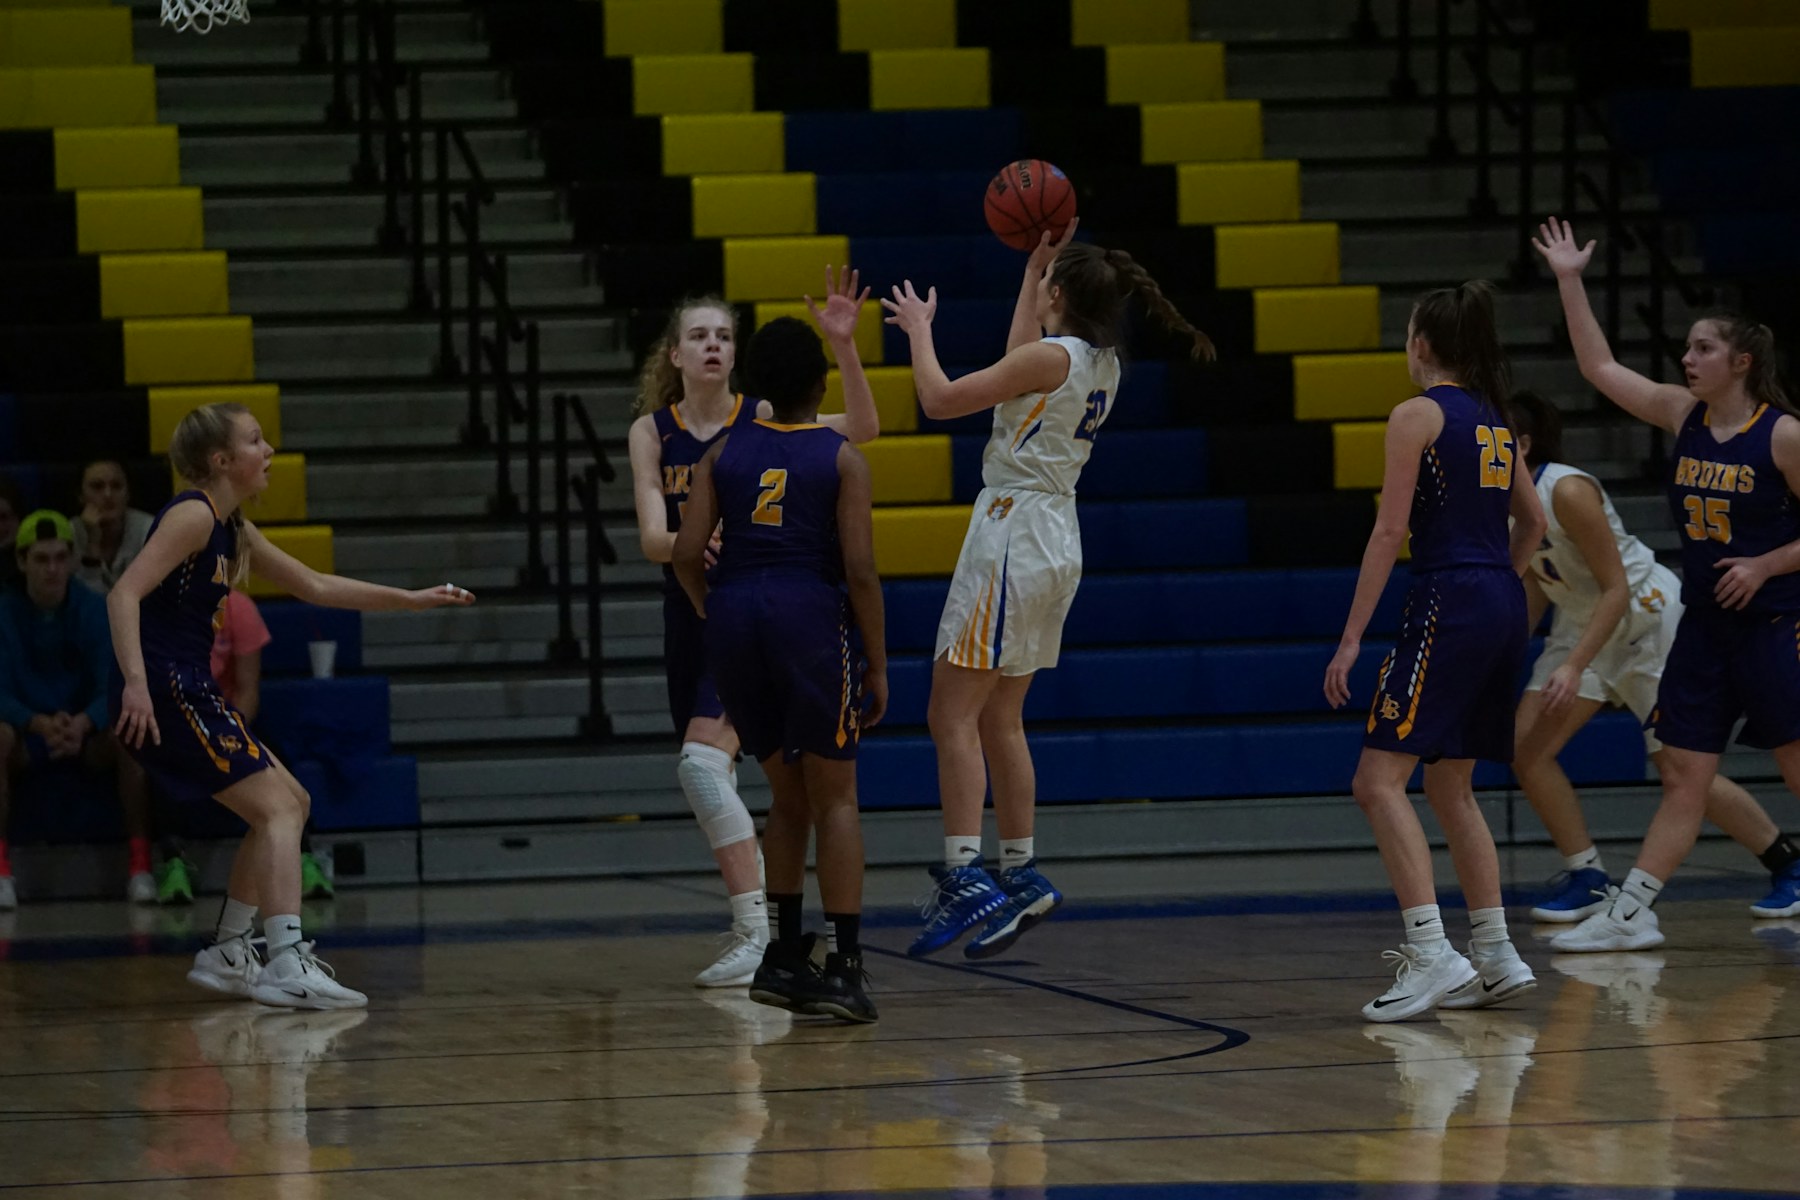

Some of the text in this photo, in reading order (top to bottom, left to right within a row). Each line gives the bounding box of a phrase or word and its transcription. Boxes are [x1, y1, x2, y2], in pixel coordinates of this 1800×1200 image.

[1475, 425, 1514, 490] 25
[1674, 456, 1757, 494] BRUINS
[751, 468, 788, 527] 2
[1682, 494, 1733, 545] 35
